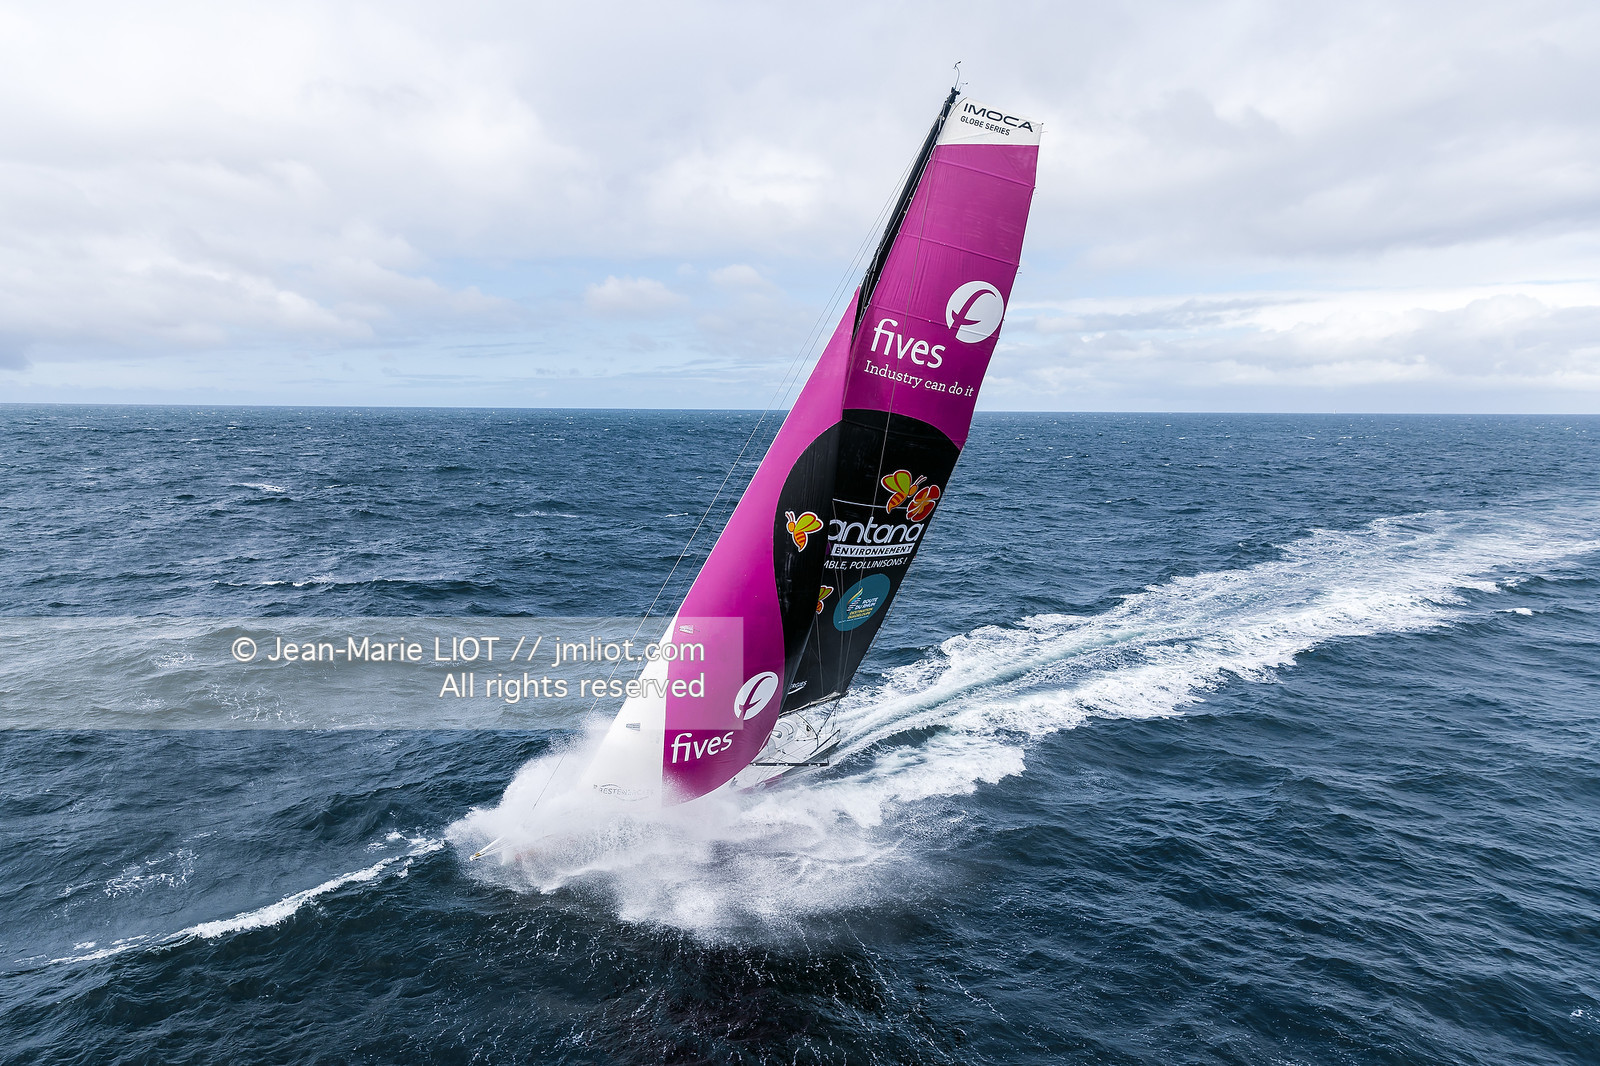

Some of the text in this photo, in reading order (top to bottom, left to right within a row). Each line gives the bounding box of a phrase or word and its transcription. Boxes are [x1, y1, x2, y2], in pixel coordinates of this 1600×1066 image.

[960, 115, 1011, 136] GLOBE SERIES
[963, 102, 1034, 133] IMOCA
[870, 317, 946, 369] fives
[864, 359, 975, 397] Industry can do it
[834, 545, 913, 556] ENVIRONNEMENT
[671, 731, 735, 764] fives
